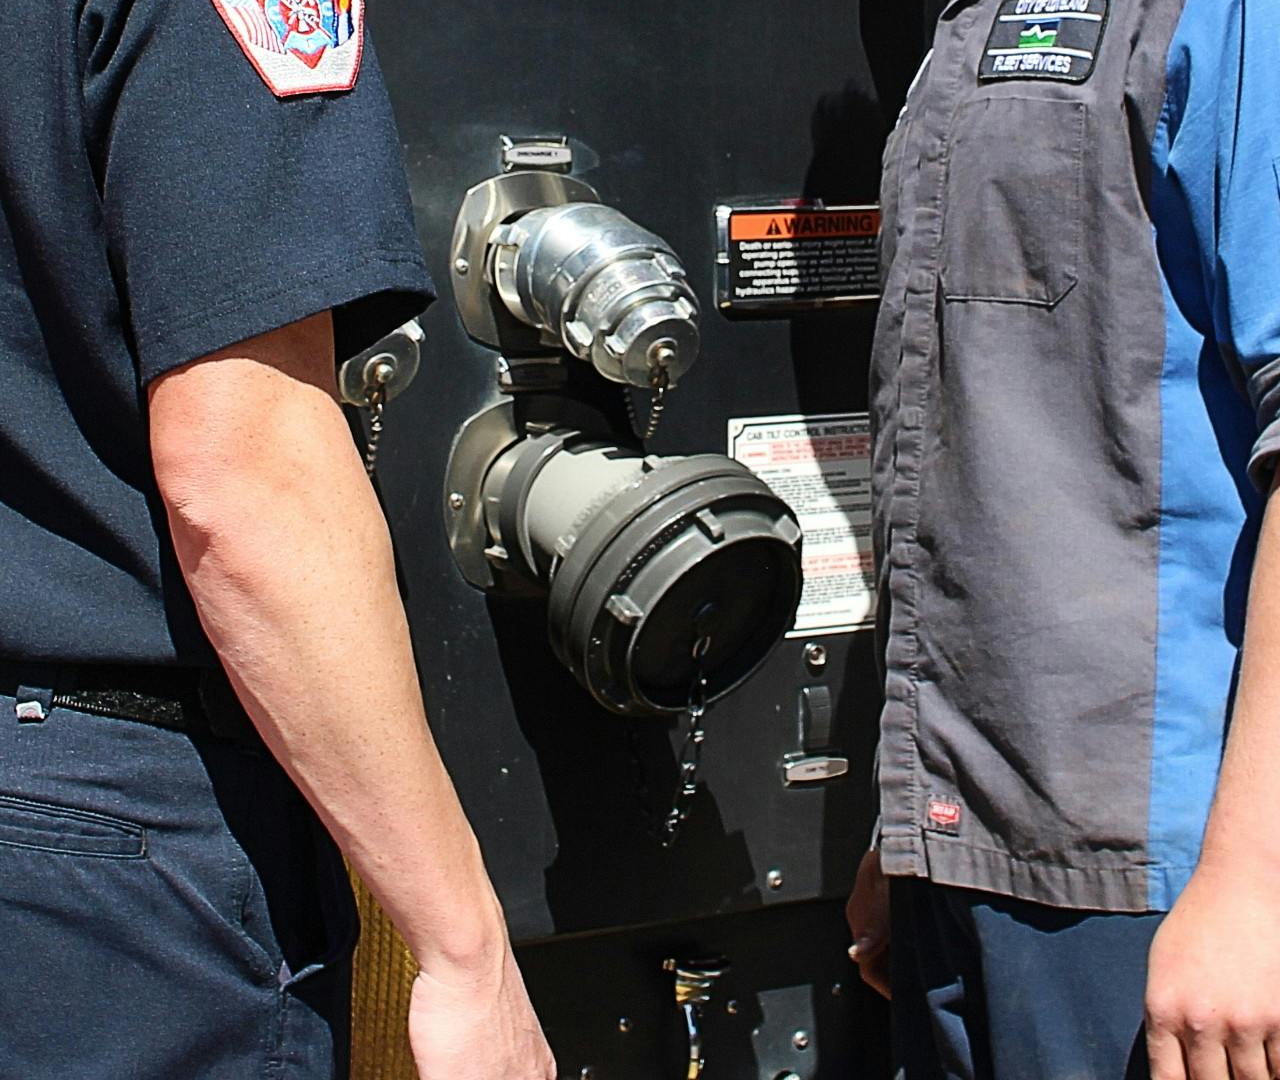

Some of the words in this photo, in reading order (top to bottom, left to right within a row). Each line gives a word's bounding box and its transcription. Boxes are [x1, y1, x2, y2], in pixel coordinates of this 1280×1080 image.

[993, 55, 1022, 72] FLEET
[1021, 53, 1072, 73] SERVICES
[784, 215, 873, 235] WARNING
